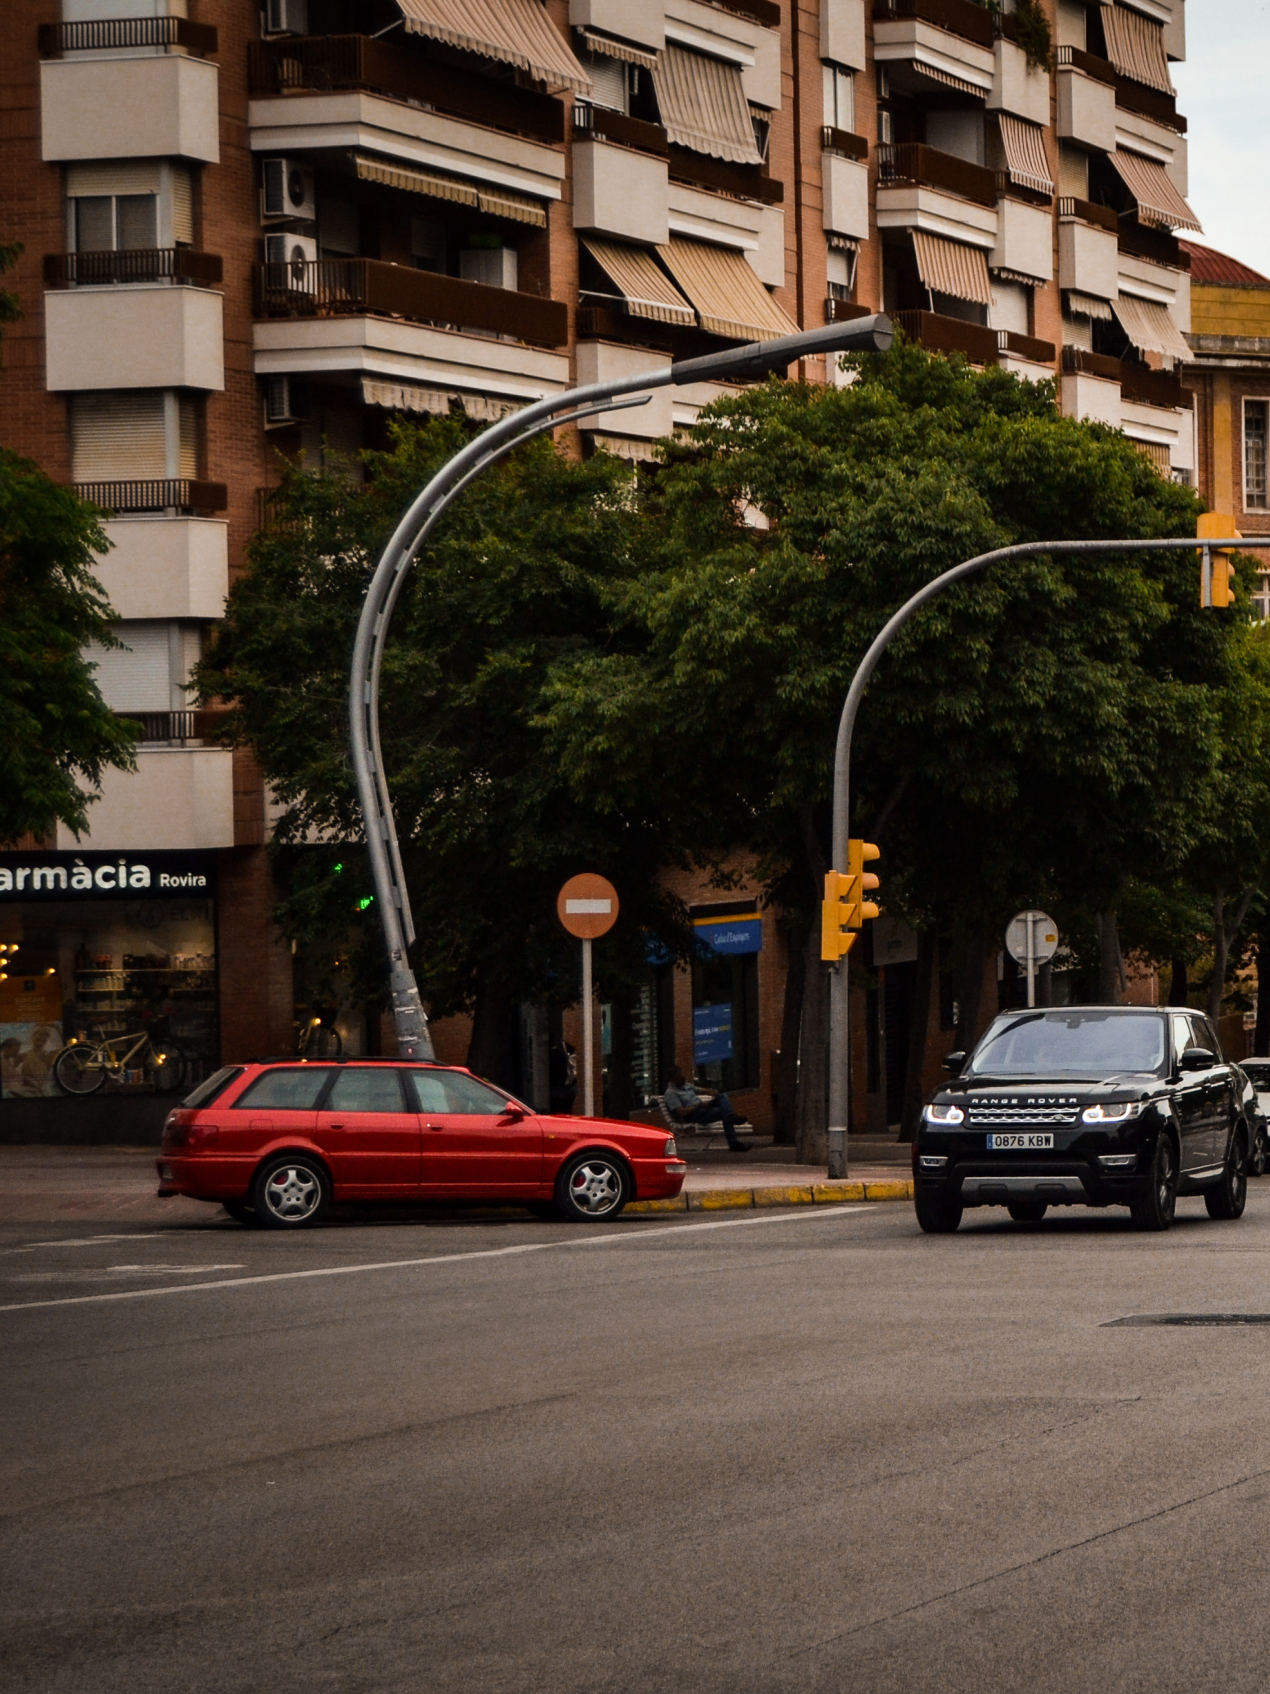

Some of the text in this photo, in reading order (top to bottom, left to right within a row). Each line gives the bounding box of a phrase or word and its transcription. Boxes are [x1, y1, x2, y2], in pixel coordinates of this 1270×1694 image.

[159, 872, 207, 888] Rovira
[995, 1135, 1051, 1147] 0876 KBW
